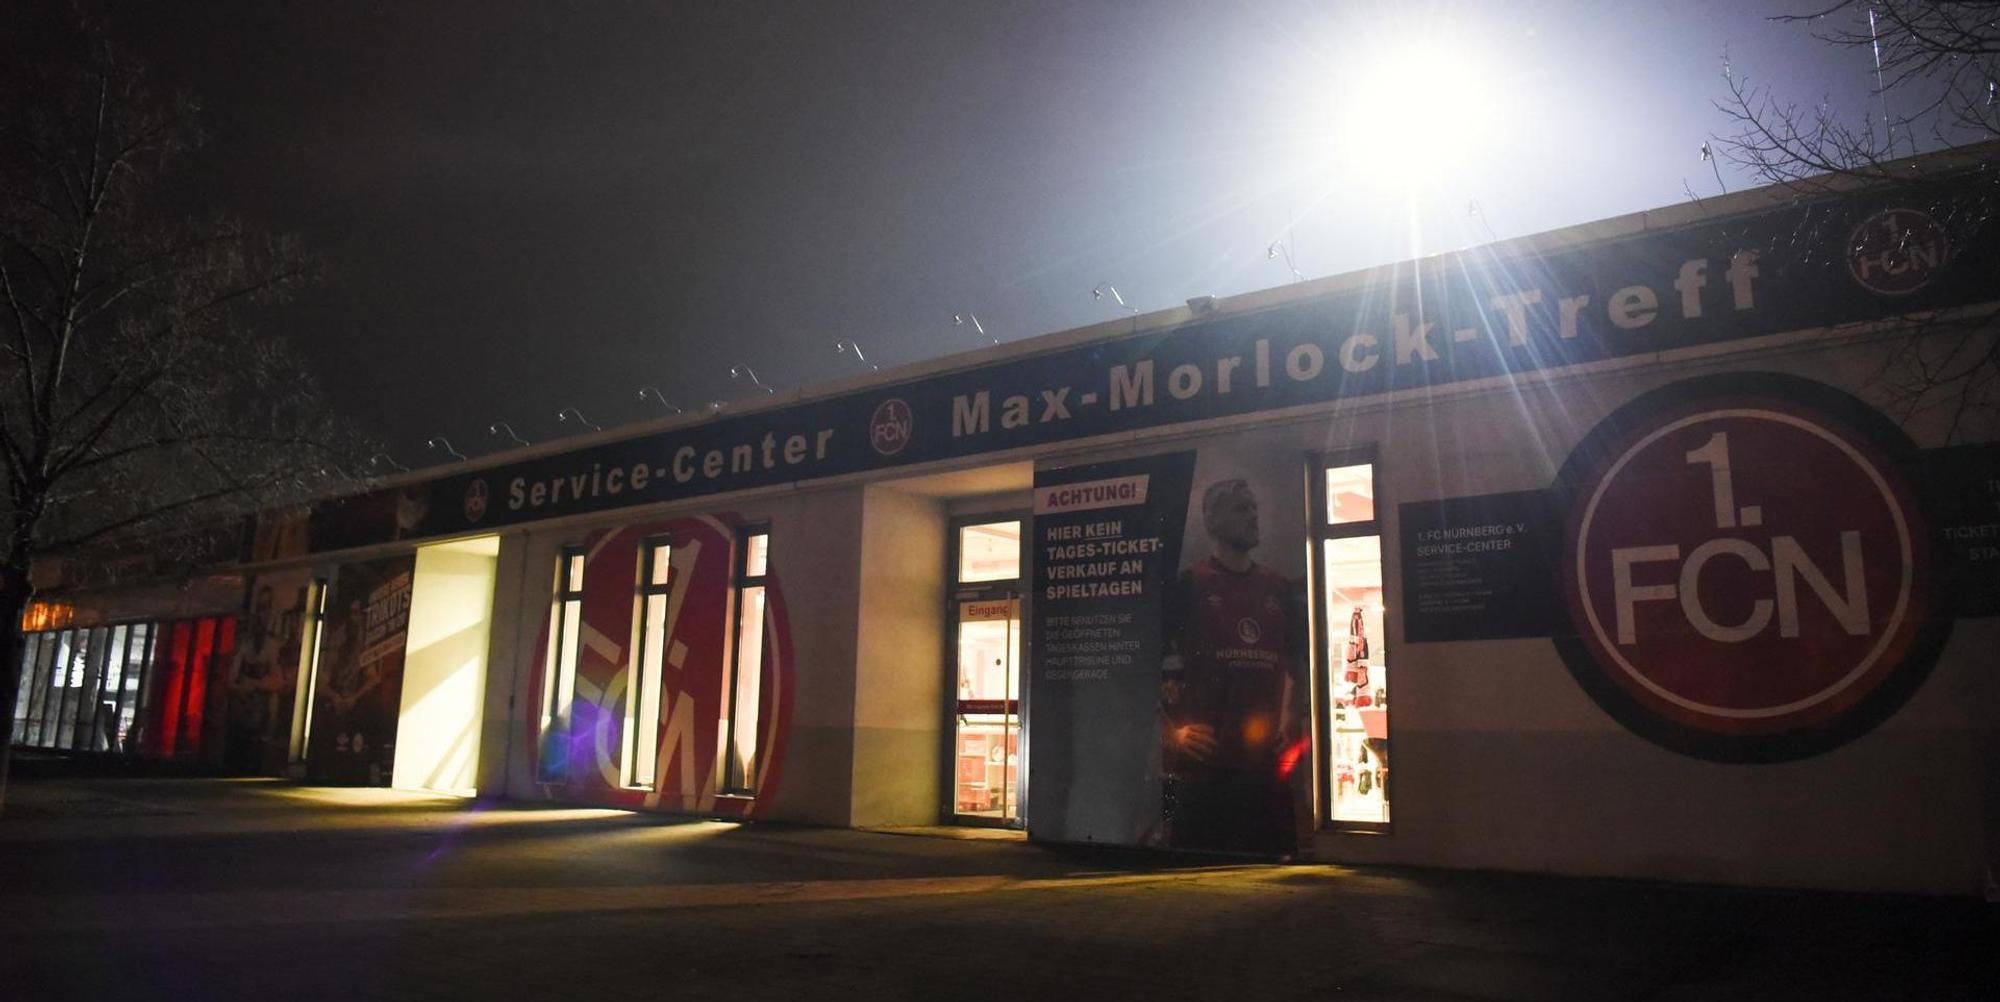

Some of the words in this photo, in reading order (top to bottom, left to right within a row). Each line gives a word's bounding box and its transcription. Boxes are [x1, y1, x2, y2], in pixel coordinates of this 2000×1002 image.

[951, 248, 1760, 438] Max-Morlock-Treff
[874, 420, 909, 443] FCN
[508, 427, 834, 511] Service-Center
[1686, 432, 1762, 528] 1.
[1047, 483, 1136, 508] ACHTUNG!
[1047, 526, 1082, 541] HIER
[1084, 521, 1122, 539] KEIN
[1427, 529, 1441, 540] FC
[1443, 524, 1505, 539] NÜRNBERG
[1047, 538, 1164, 560] TAGES-TICKET-
[1416, 539, 1511, 557] SERVICE-CENTER
[1047, 562, 1117, 580] VERKAUF
[1119, 560, 1143, 575] AN
[1046, 580, 1143, 600] SPIELTAGEN
[1612, 530, 1871, 645] FCN
[1111, 655, 1132, 665] UND
